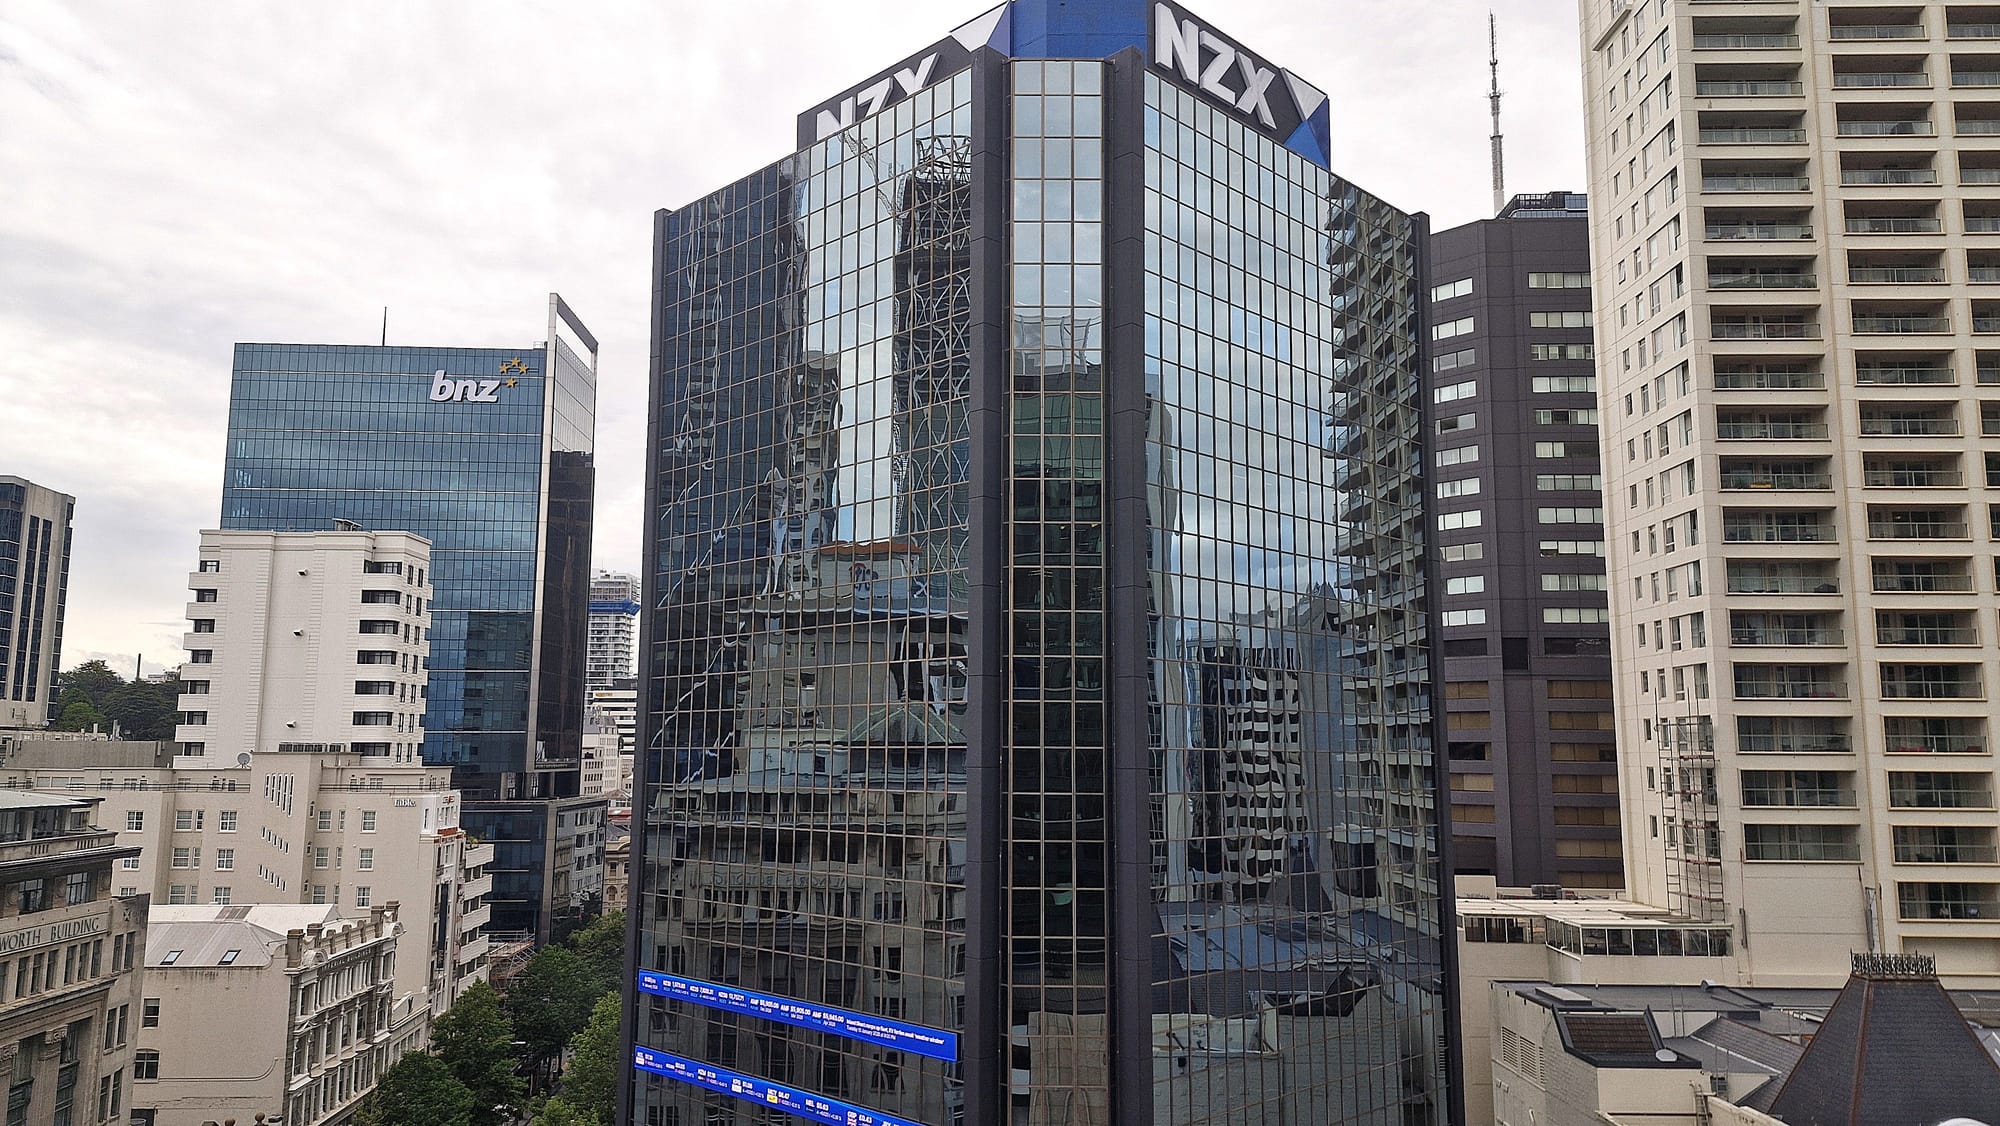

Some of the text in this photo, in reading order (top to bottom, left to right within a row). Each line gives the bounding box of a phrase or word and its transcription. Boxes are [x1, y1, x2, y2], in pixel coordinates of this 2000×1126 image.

[1154, 2, 1277, 129] NZX
[430, 369, 500, 404] bnz
[0, 917, 100, 950] WORTH BUILDING
